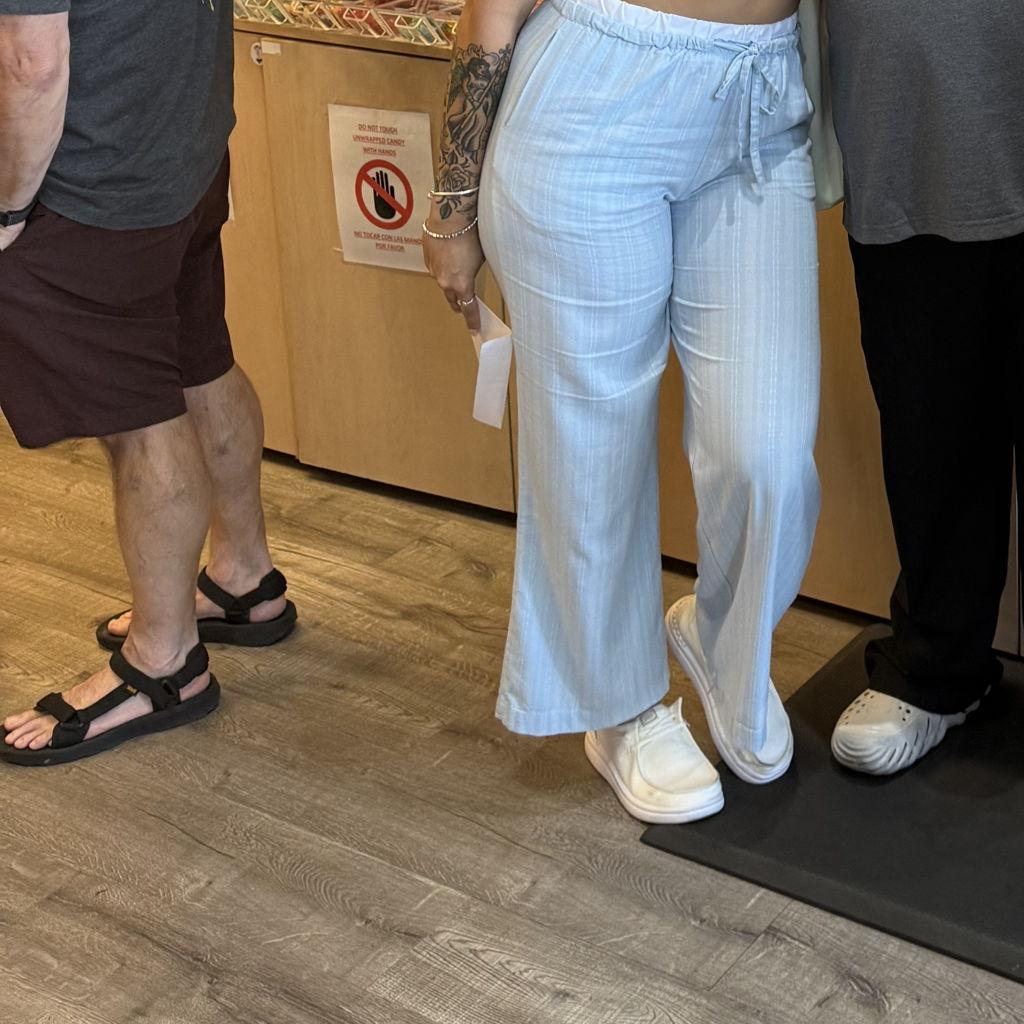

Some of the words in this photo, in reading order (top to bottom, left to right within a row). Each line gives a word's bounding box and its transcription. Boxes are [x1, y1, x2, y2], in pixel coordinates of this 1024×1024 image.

[358, 123, 366, 131] DO
[367, 124, 378, 133] NOT
[352, 134, 386, 145] UNWRAPPED
[386, 137, 405, 147] CANDY
